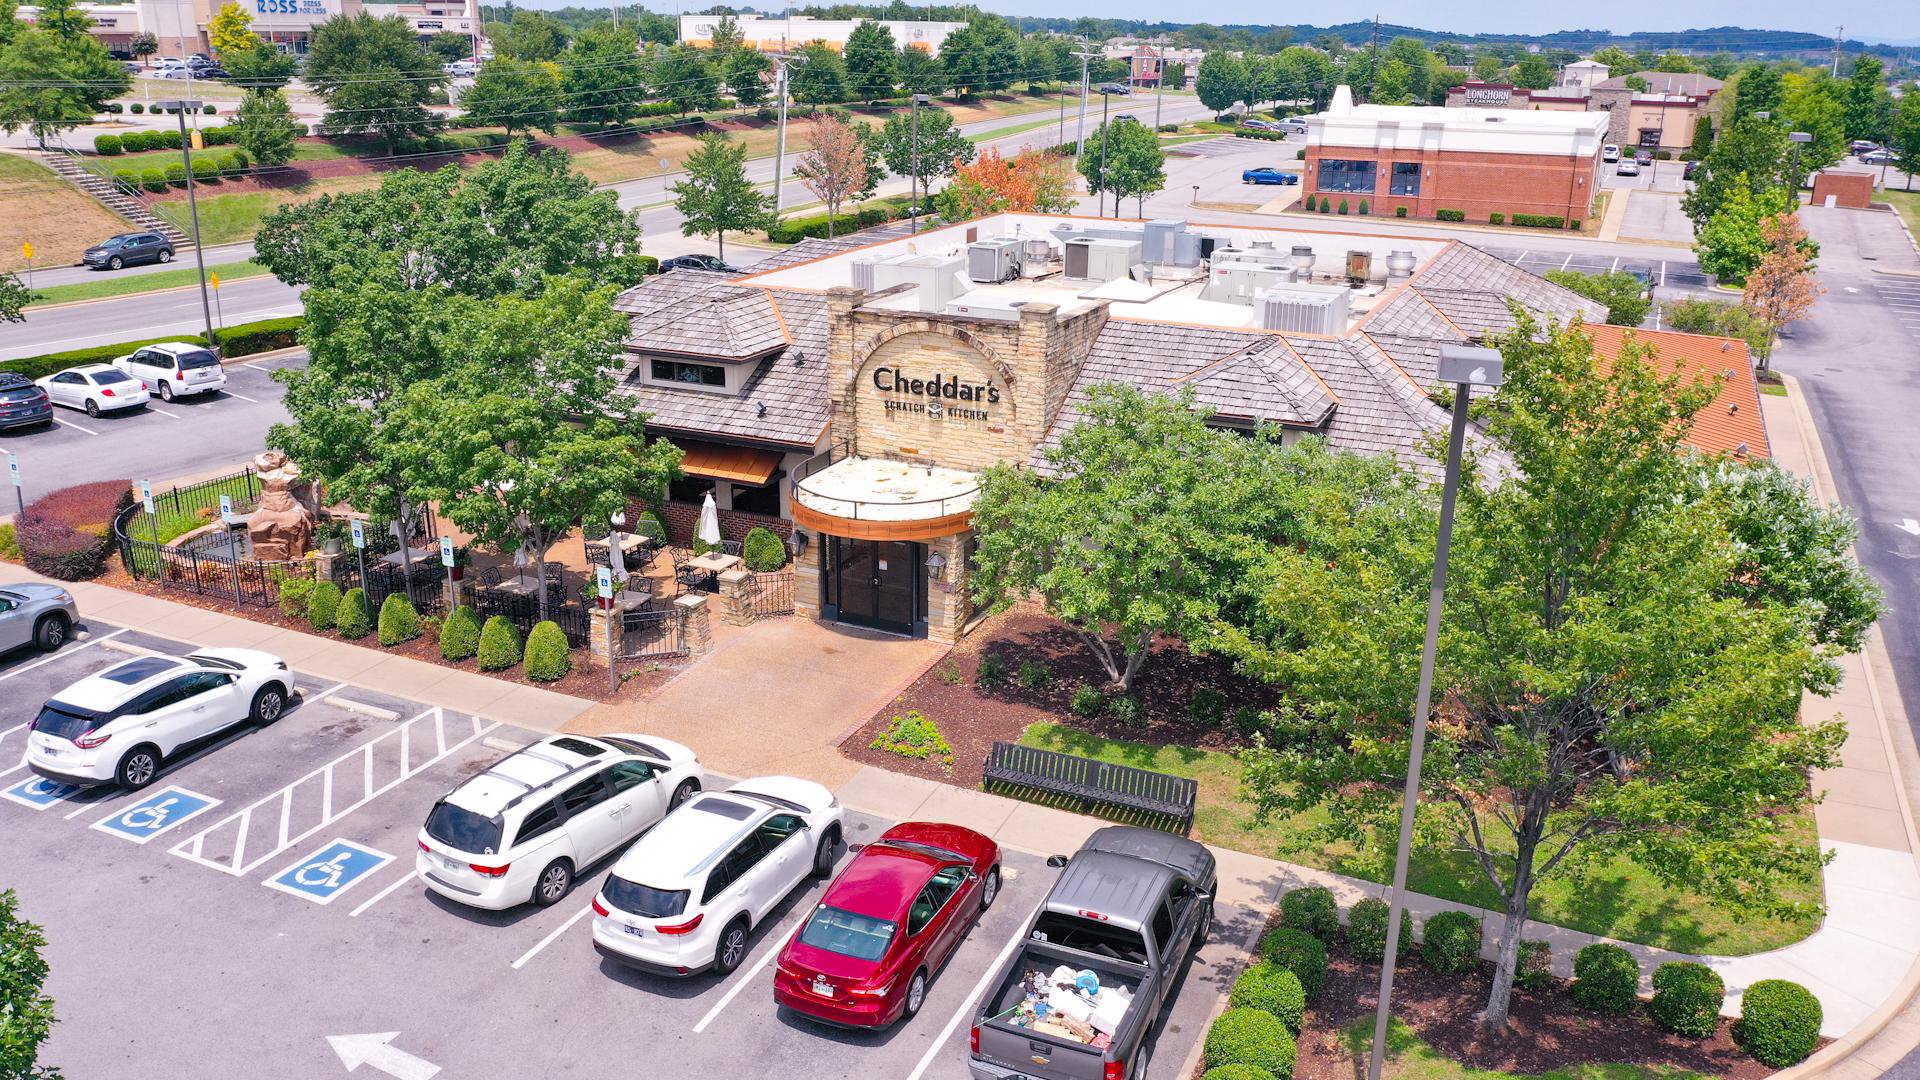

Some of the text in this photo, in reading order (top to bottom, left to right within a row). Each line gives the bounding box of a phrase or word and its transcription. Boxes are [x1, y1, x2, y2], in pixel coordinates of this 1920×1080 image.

[257, 0, 298, 13] ROSS
[1467, 89, 1509, 100] LONGHORN
[873, 367, 1000, 403] Cheddar's
[884, 400, 989, 421] SCRATCH KITCHEN
